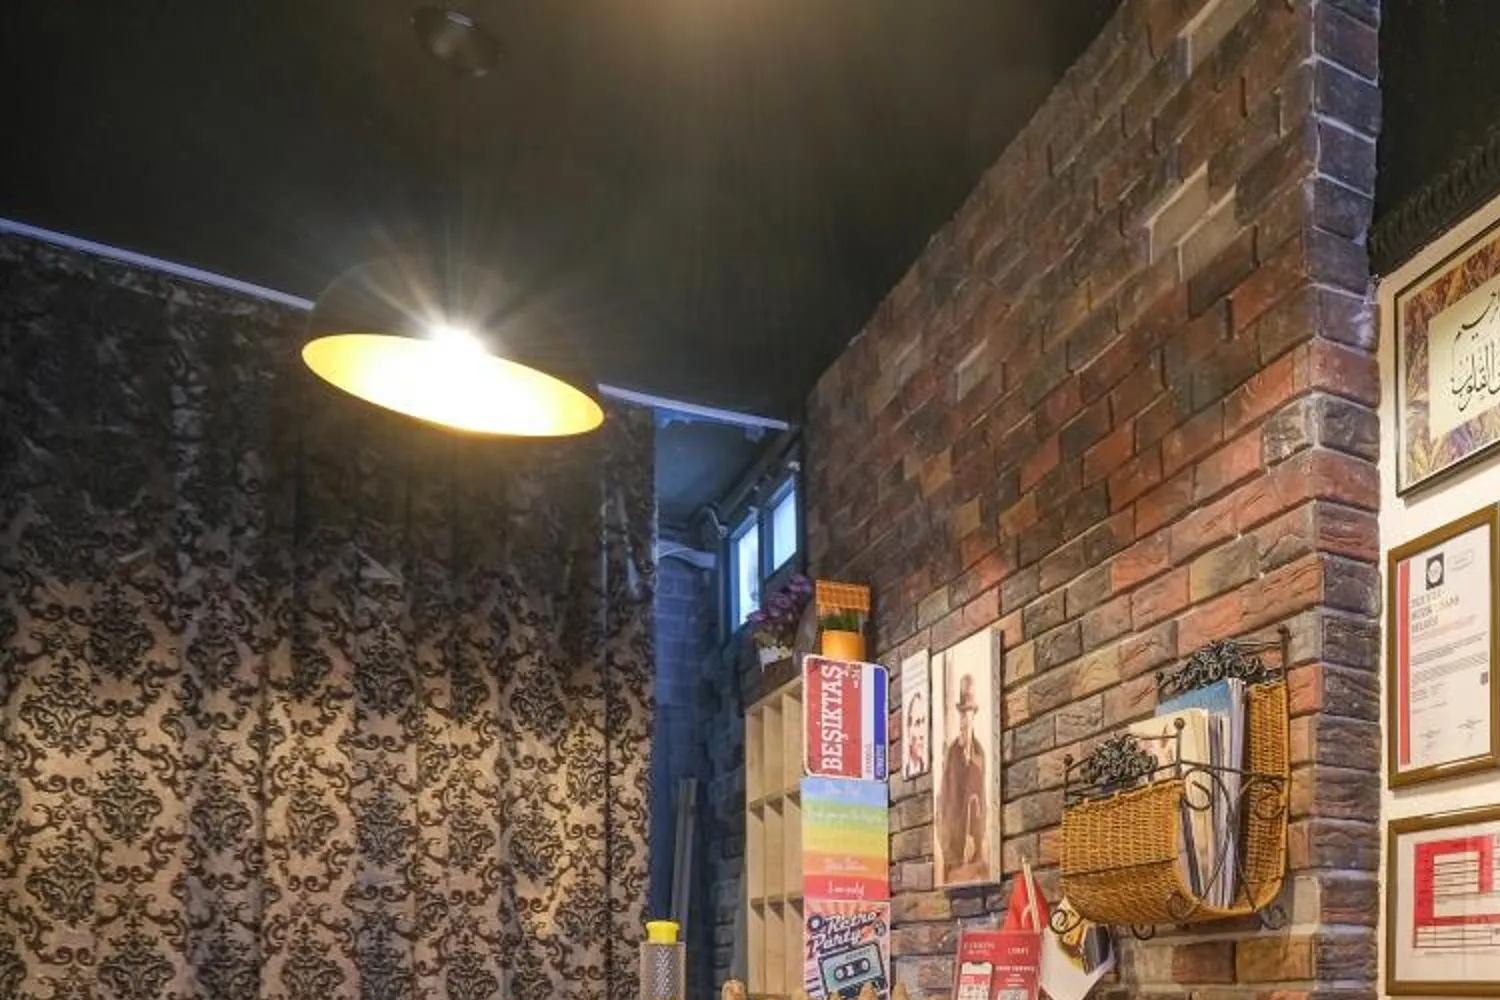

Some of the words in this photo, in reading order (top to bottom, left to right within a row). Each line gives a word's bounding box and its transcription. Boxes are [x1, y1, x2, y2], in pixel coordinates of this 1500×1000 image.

[816, 663, 849, 771] BEŞİKTAŞ
[824, 911, 878, 934] Retro
[811, 931, 862, 950] Party
